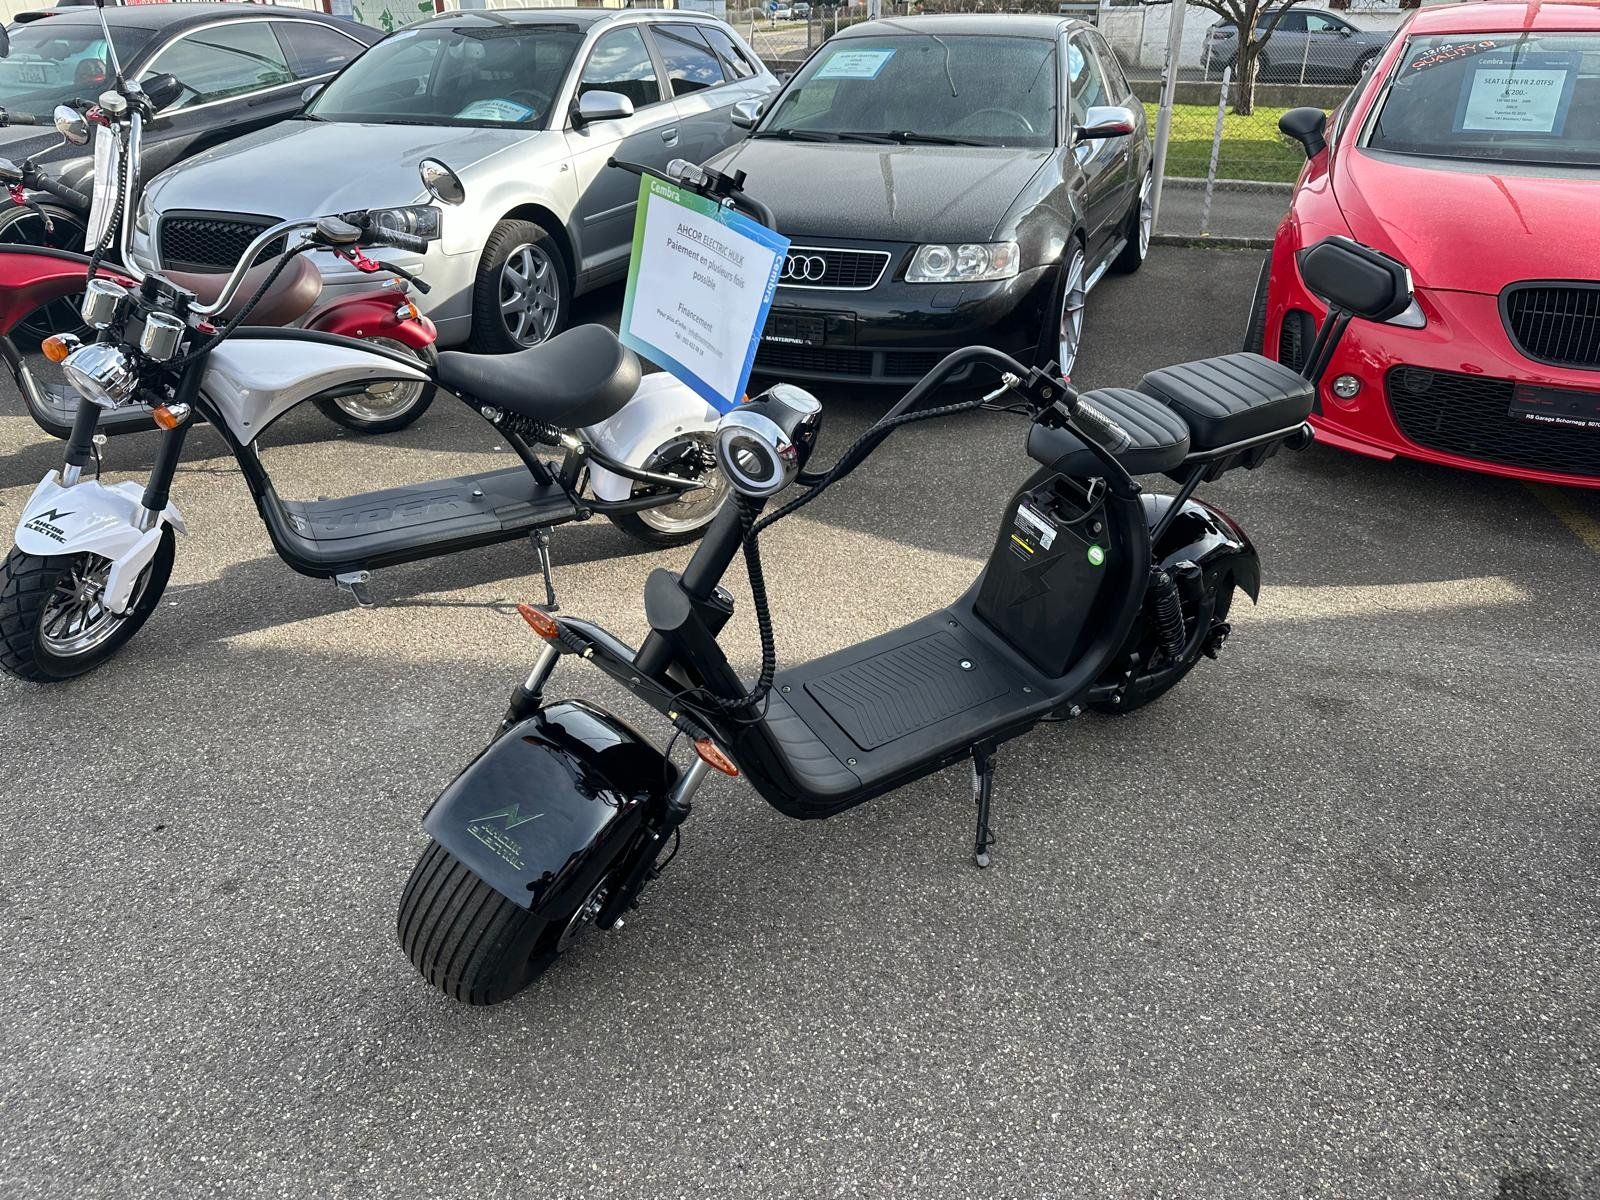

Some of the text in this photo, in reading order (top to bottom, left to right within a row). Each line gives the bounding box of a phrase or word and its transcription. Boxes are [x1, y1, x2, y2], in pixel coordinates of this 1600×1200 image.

[650, 180, 680, 202] Cembra
[677, 223, 703, 241] AHCOR
[702, 235, 729, 257] ELECTRIC
[666, 238, 745, 288] Paiement en plusieurs fois
[692, 271, 716, 290] possible
[763, 255, 783, 304] Cembra
[677, 302, 713, 333] Financement
[765, 335, 804, 345] MASTERPNEU
[24, 522, 67, 544] ELECTRIC
[33, 519, 65, 535] AHCOR
